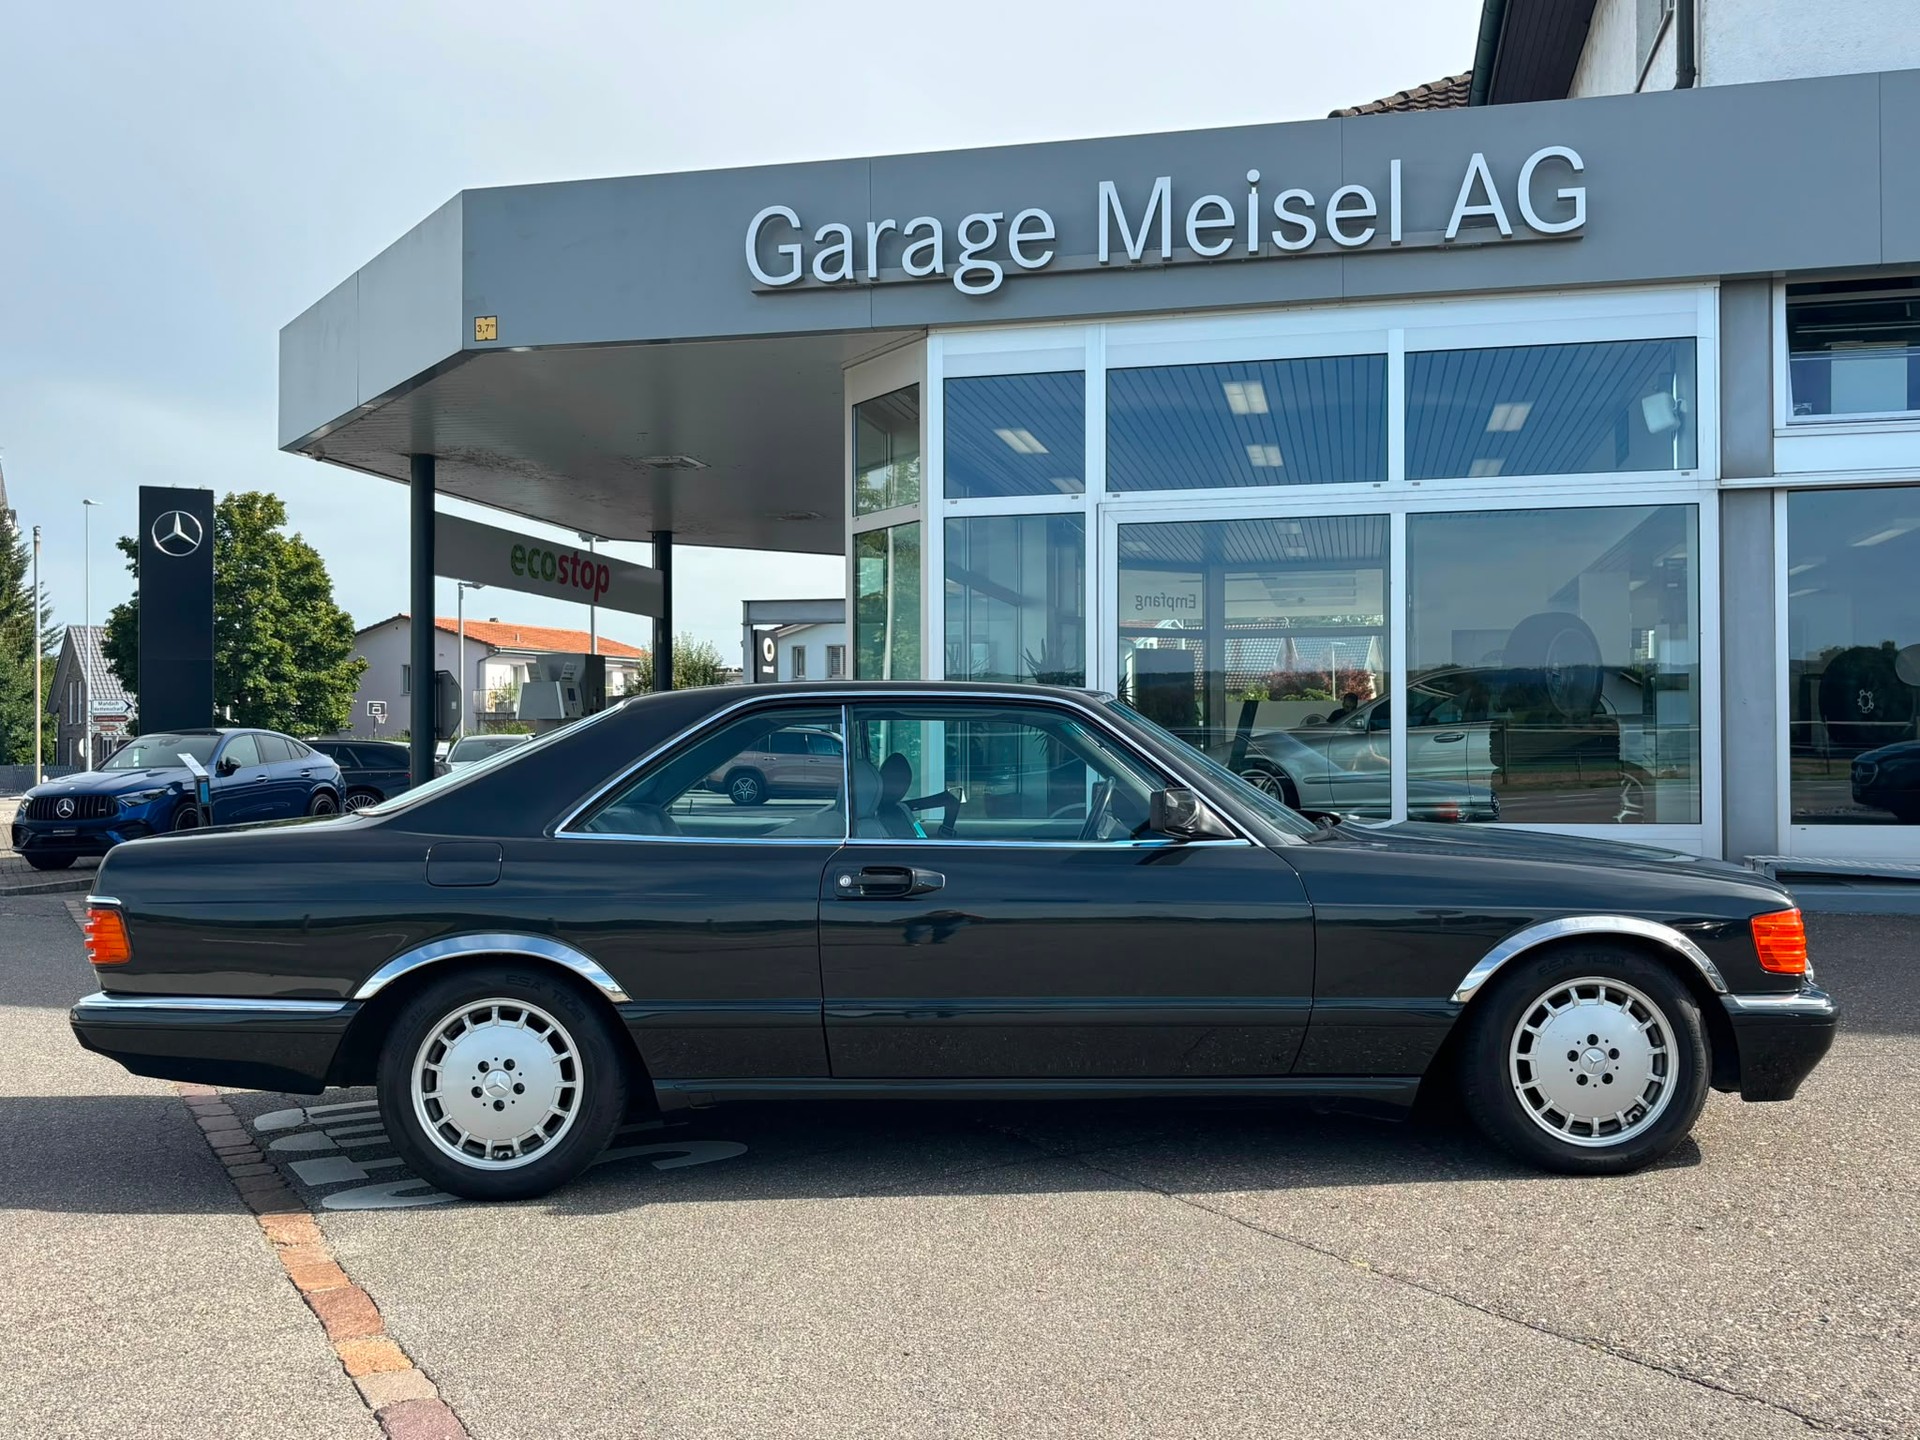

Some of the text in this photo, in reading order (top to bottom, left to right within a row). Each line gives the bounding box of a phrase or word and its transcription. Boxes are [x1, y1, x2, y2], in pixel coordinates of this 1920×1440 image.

[745, 145, 1588, 295] Garage Meisel AG
[510, 543, 610, 603] ecostop
